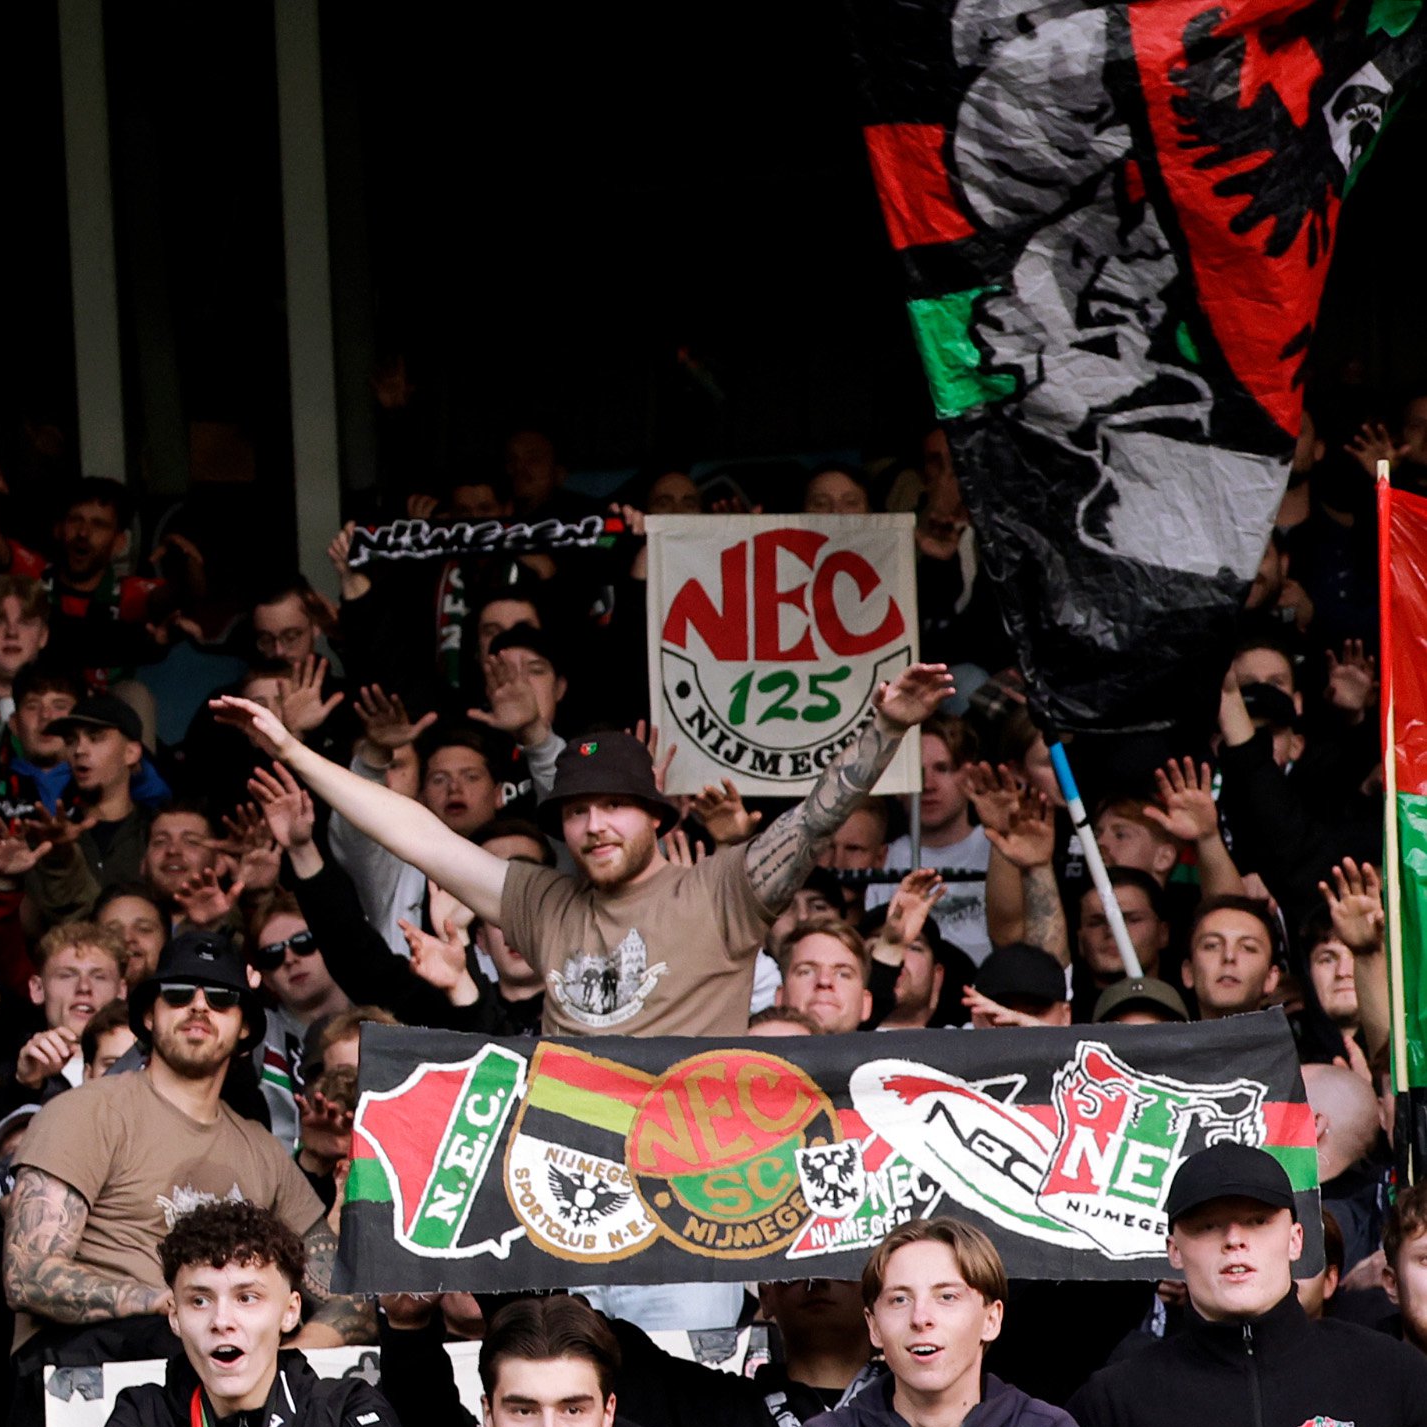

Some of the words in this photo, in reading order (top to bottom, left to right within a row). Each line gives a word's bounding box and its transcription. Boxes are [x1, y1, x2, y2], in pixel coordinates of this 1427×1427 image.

[662, 528, 905, 661] NEC
[728, 665, 852, 726] 125
[637, 1061, 812, 1167] NEC
[424, 1087, 506, 1226] N.E.C.
[701, 1157, 789, 1214] SC
[863, 1166, 933, 1212] NEC
[1060, 1125, 1181, 1204] NE
[514, 1167, 597, 1249] SPORTCLUB
